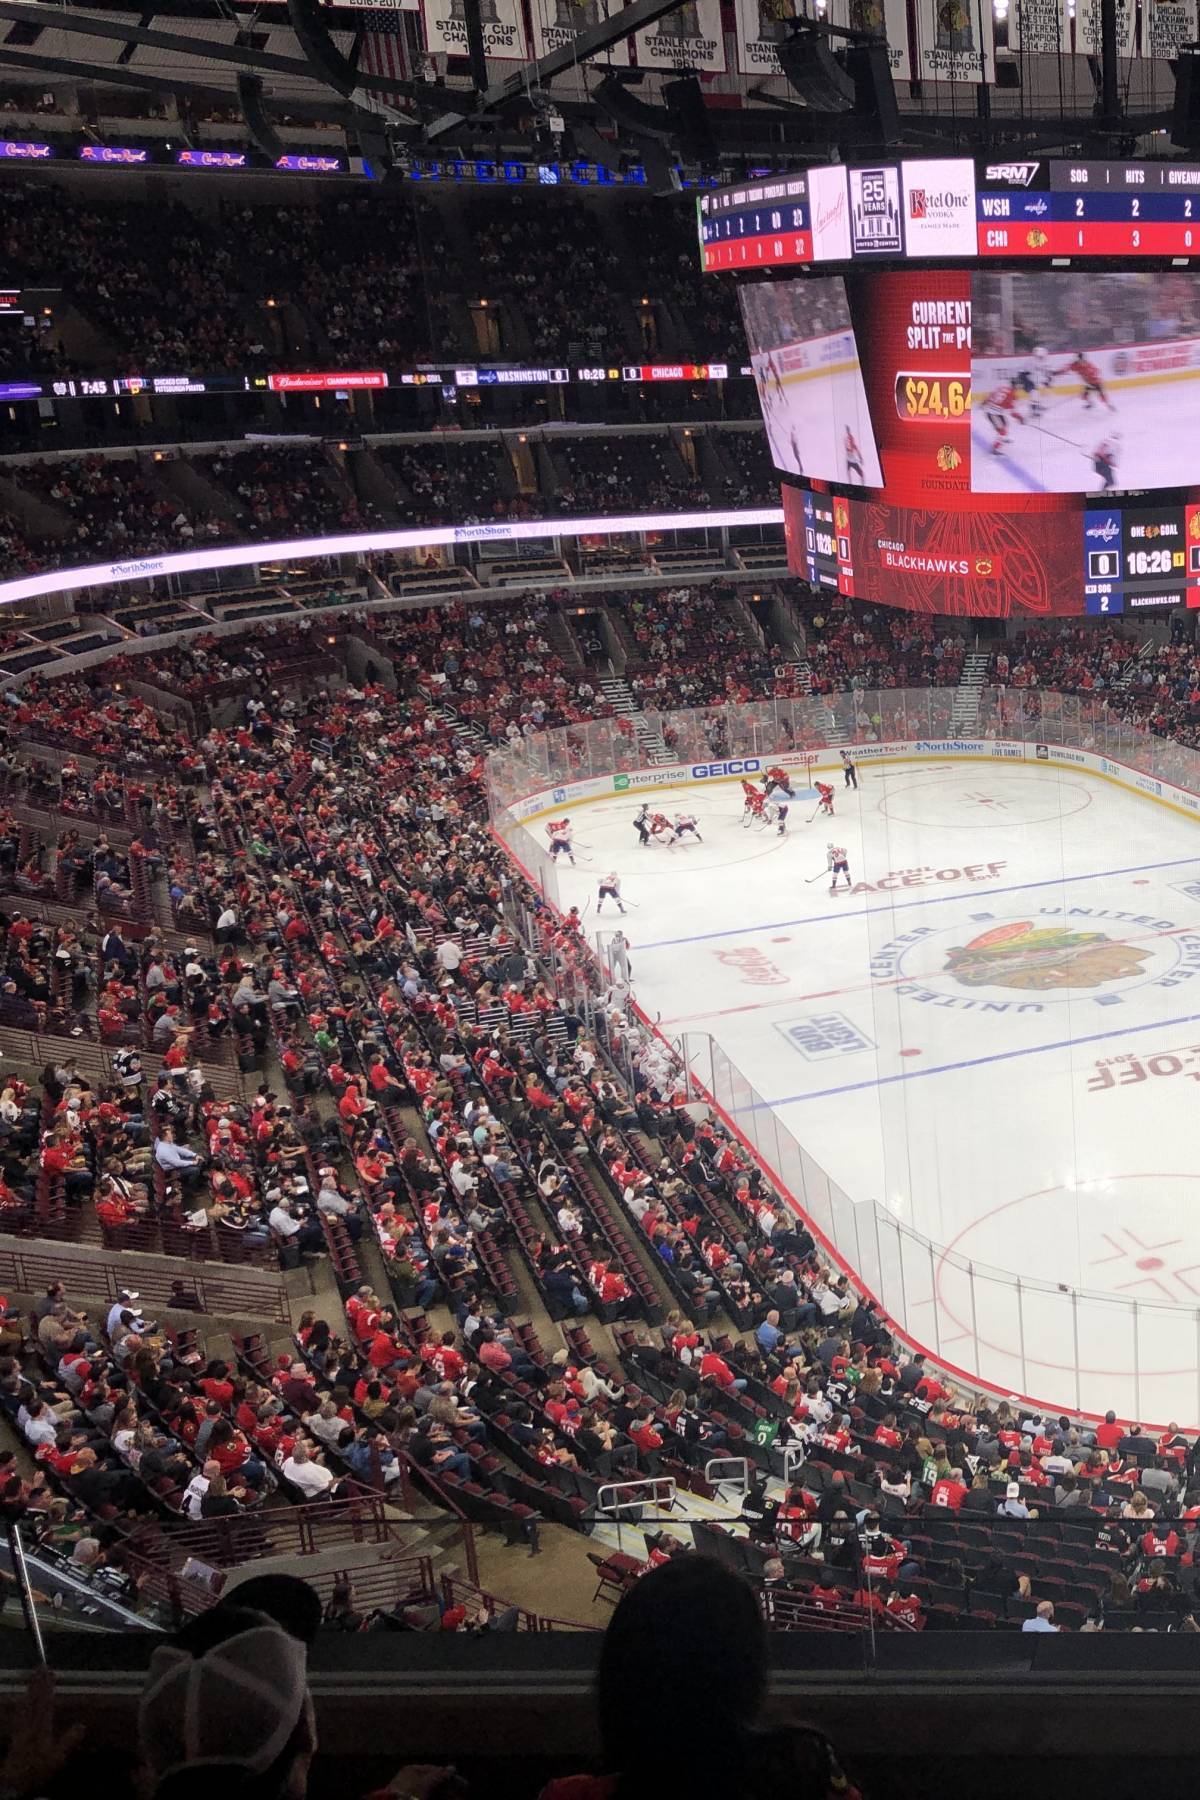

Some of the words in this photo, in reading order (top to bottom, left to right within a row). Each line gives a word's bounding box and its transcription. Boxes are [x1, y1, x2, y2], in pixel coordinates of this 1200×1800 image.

[492, 25, 517, 35] CUP
[695, 39, 718, 50] CUP
[650, 47, 714, 60] CHAMPIONS
[968, 53, 988, 63] CUP
[928, 60, 984, 71] CHAMPIONS
[985, 166, 1028, 180] SRM
[1070, 169, 1089, 183] SOG
[1125, 170, 1145, 183] HITS
[863, 180, 885, 202] 25
[863, 202, 885, 212] YEARS
[909, 189, 943, 218] Ketel
[944, 191, 968, 208] One
[982, 198, 1011, 216] WSH
[1075, 198, 1084, 216] 2
[1131, 198, 1140, 217] 2
[1184, 199, 1192, 217] 2
[986, 229, 1009, 247] CHI
[1132, 230, 1140, 247] 3
[1184, 230, 1192, 247] 0
[907, 326, 941, 350] SPLIT
[942, 333, 955, 344] THE
[402, 374, 414, 384] ONE
[497, 370, 548, 383] WASHINGTON
[555, 371, 562, 380] 0
[578, 369, 605, 380] 16:26
[630, 369, 636, 379] 0
[651, 367, 683, 378] CHICAGO
[80, 381, 107, 395] 7:45
[277, 377, 324, 388] Budweiser
[327, 377, 362, 386] CHAMPIONS
[363, 376, 380, 385] CLUB
[458, 526, 511, 537] NorthShore
[1130, 526, 1145, 538] ONE
[1160, 524, 1178, 536] GOAL
[841, 539, 848, 559] 0
[877, 539, 905, 553] CHICAGO
[114, 561, 164, 574] NorthShore
[886, 552, 970, 575] BLACKHAWKS
[1099, 554, 1110, 576] 0
[1127, 549, 1172, 575] 16:26
[1098, 584, 1112, 594] SOG
[1100, 596, 1109, 612] 2
[1130, 595, 1181, 607] BLACKHAWKS.COM
[843, 745, 908, 756] WeatherTech
[922, 741, 984, 751] NorthShore
[1003, 749, 1022, 757] GAMES
[692, 759, 760, 779] GEICO
[1107, 765, 1120, 776] AT&T
[887, 866, 936, 877] NHL
[1039, 907, 1175, 929] UNITED
[870, 926, 938, 979] CENTER
[893, 985, 1044, 1013] UNITED
[788, 1025, 835, 1053] BUD
[809, 1015, 868, 1052] LIGHT
[1094, 1053, 1137, 1068] 2019
[922, 1468, 938, 1485] 19
